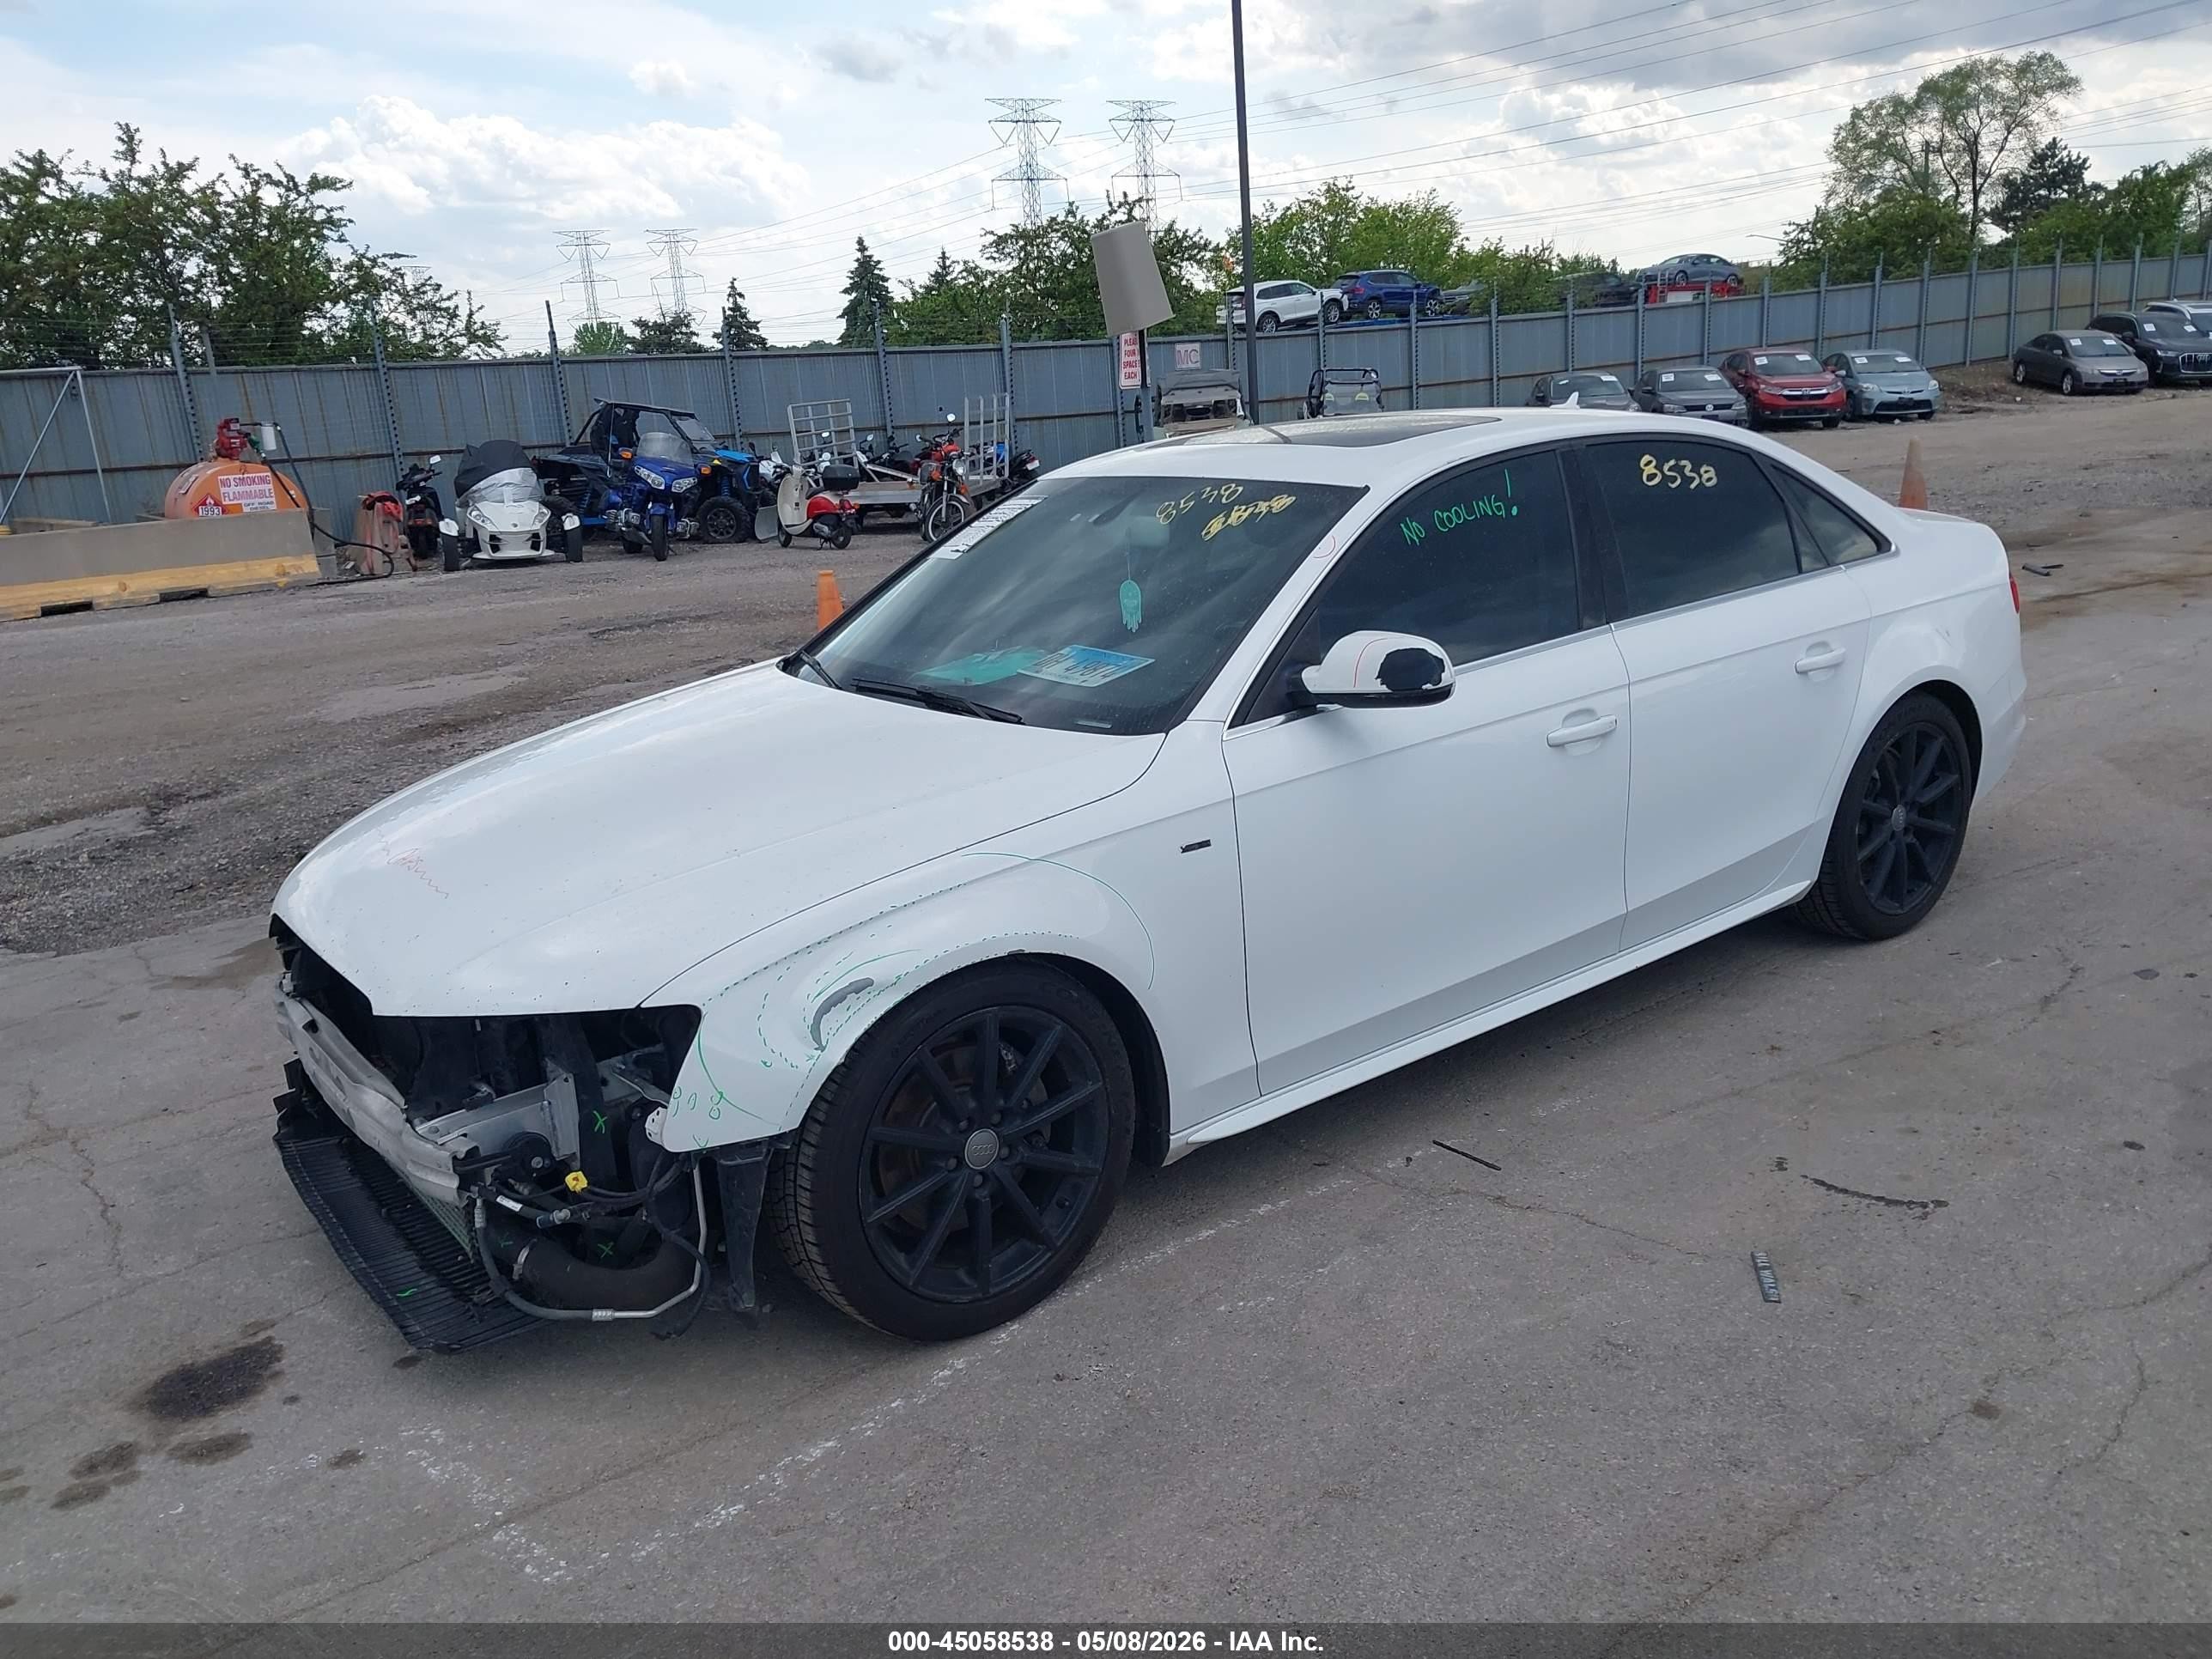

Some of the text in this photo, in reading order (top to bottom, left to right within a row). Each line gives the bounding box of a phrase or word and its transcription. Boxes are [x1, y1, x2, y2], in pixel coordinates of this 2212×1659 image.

[1124, 349, 1135, 357] FOUR
[1176, 349, 1200, 365] MC
[1124, 371, 1138, 380] EACH
[1639, 453, 1718, 490] 8538
[219, 474, 271, 489] NO SMOKING
[222, 488, 274, 502] FLAMMABLE
[200, 507, 221, 516] 1993
[1400, 468, 1518, 546] NO COOLING!
